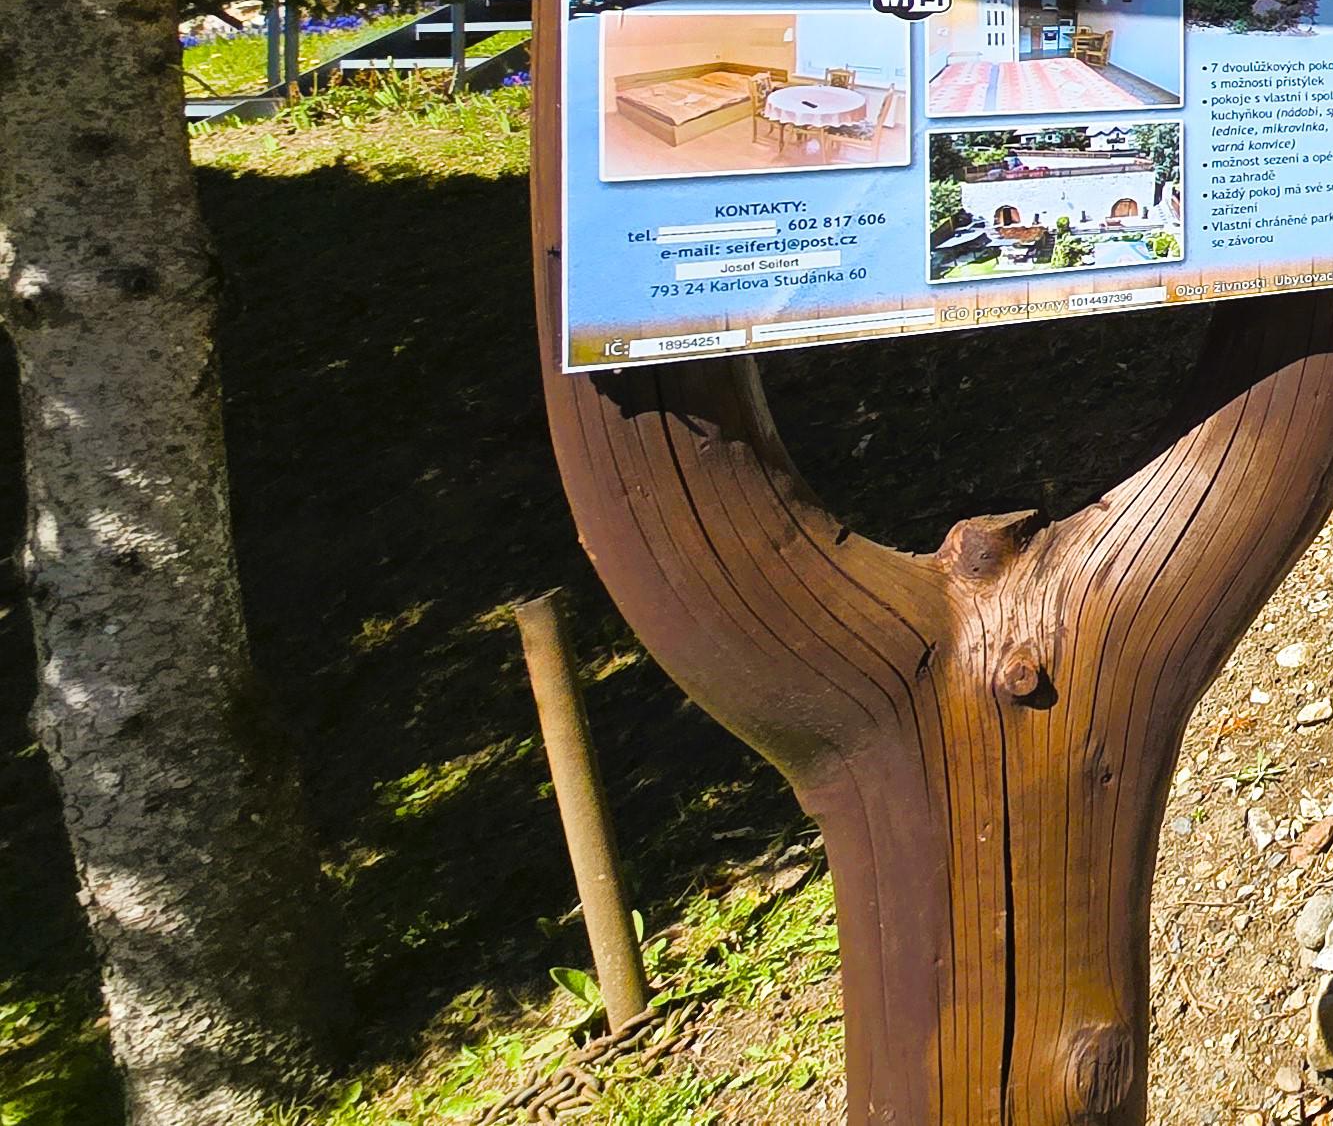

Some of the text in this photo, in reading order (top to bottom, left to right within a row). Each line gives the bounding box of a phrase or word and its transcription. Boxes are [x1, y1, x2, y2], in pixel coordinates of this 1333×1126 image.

[1211, 62, 1218, 73] 7
[1222, 61, 1305, 73] dvoulůžkových
[1211, 80, 1217, 89] s
[1220, 76, 1272, 89] možností
[1211, 94, 1251, 107] pokoje
[1255, 94, 1260, 103] s
[1264, 91, 1301, 103] vlastní
[1211, 108, 1273, 122] kuchyňkou
[1212, 122, 1329, 137] lednice, mikrovlnka,
[1212, 138, 1296, 152] varná konvice)
[1211, 156, 1260, 169] možnost
[1263, 153, 1299, 166] sezení
[1303, 154, 1309, 163] a
[1211, 170, 1276, 185] na zahradě
[1211, 187, 1246, 201] každý
[1249, 185, 1281, 200] pokoj
[1284, 183, 1301, 195] má
[1304, 182, 1324, 194] své
[714, 201, 807, 218] KONTAKTY:
[1211, 202, 1258, 216] zařízení
[628, 213, 886, 243] tel. 602 817 606
[1211, 219, 1252, 232] Vlastní
[660, 235, 858, 260] e-mail: seifertj@post.cz
[1211, 234, 1274, 248] se závorou
[720, 258, 800, 274] Josef Seifert
[650, 268, 867, 298] 793 24 Karlova Studánka 60
[1175, 282, 1209, 297] Obor
[940, 293, 1133, 322] IČO provozovny: 1014497396
[603, 335, 722, 357] IČ: 18954251
